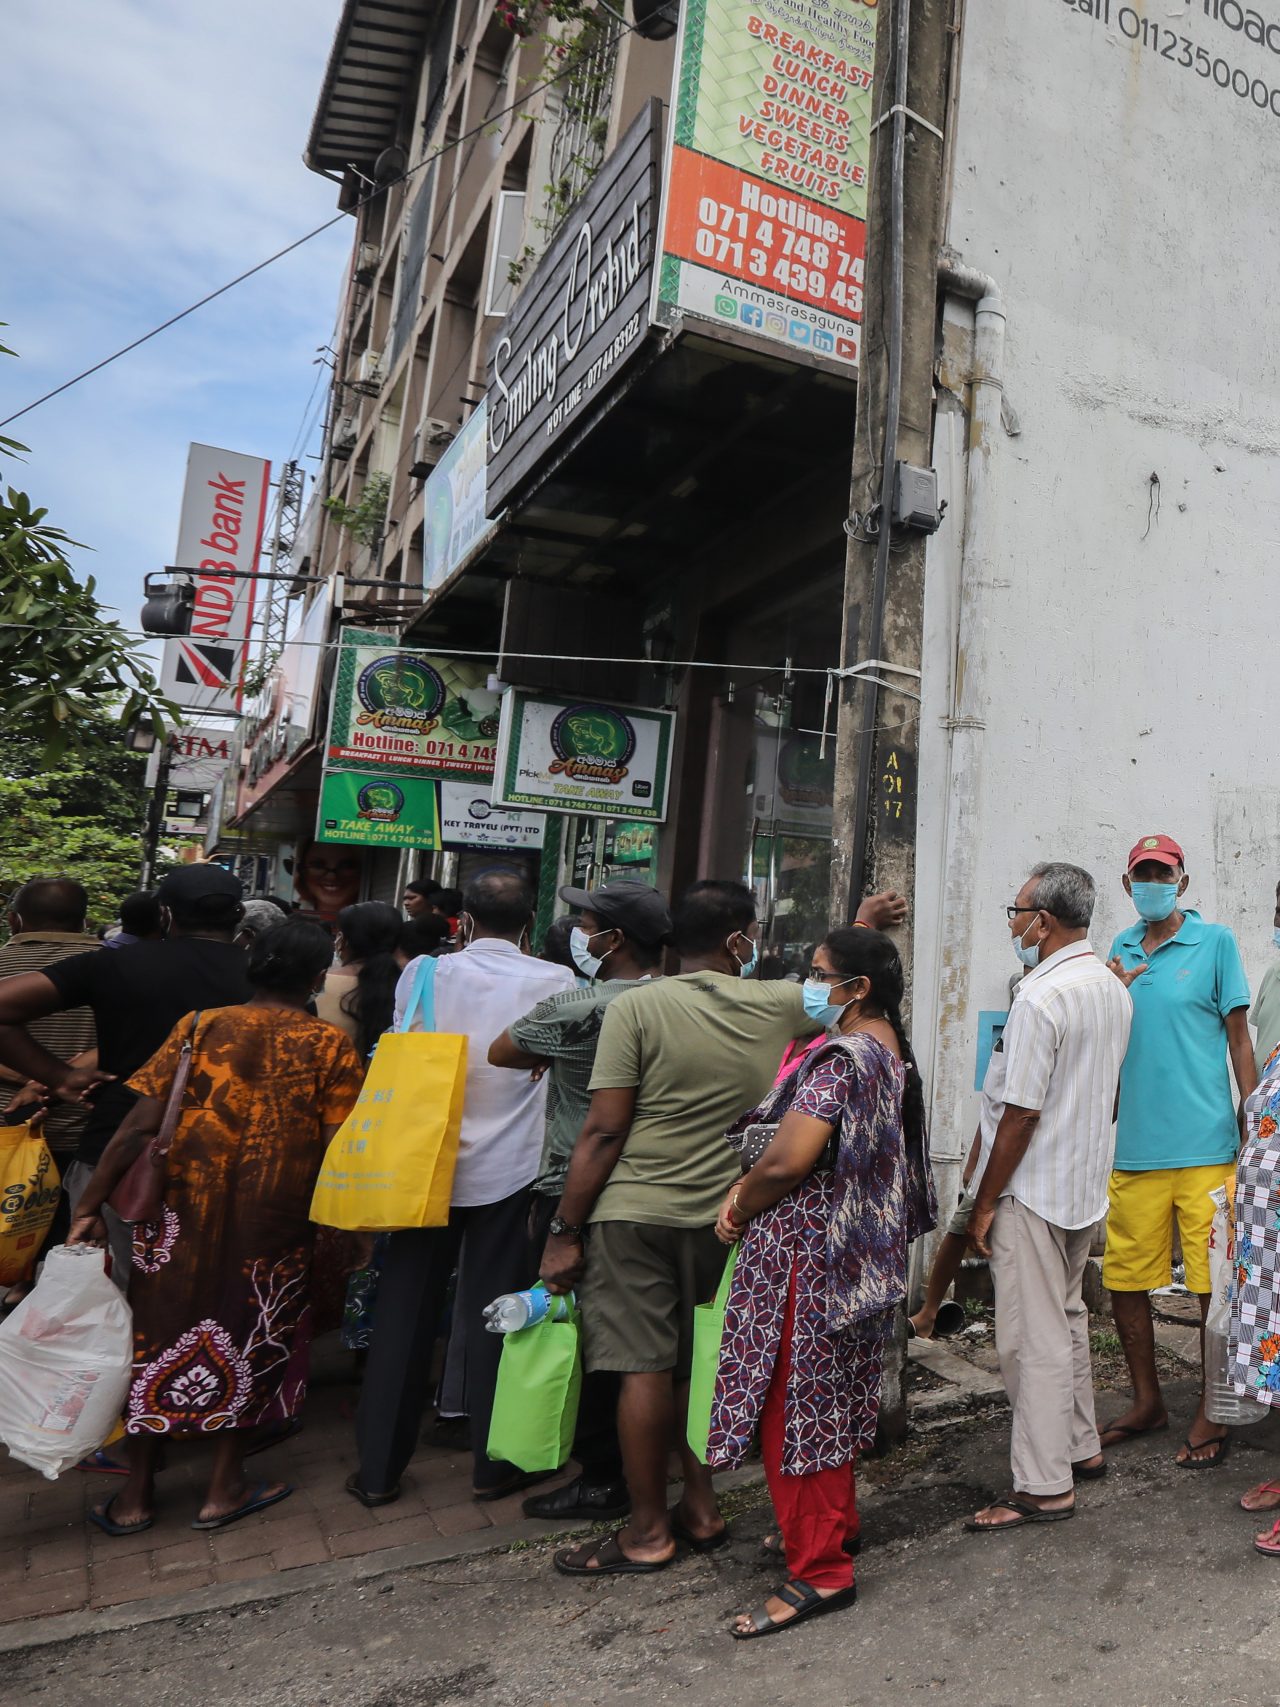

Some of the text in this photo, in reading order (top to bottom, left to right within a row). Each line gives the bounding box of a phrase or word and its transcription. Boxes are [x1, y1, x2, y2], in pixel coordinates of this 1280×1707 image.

[807, 7, 849, 37] Healthy
[747, 15, 873, 88] BREAKFAST
[772, 53, 847, 101] LUNCH
[763, 75, 851, 130] DINNER
[739, 115, 865, 184] VEGETABLE
[759, 101, 849, 152] SWEETS
[761, 152, 841, 198] FRUITS
[699, 197, 749, 239] 071
[755, 220, 774, 248] 4
[781, 228, 830, 270] 748
[740, 181, 846, 247] Hotline:
[695, 228, 744, 269] 071
[749, 248, 768, 277] 3
[772, 258, 826, 299] 439
[490, 200, 641, 454] Smiling Orchid
[721, 279, 854, 337] Ammasrasaguna
[547, 403, 564, 436] HOT
[564, 382, 582, 416] LINE
[587, 357, 603, 389] 077
[602, 345, 614, 371] 44
[614, 313, 640, 359] 83122
[191, 472, 246, 638] NDB bank
[339, 749, 381, 761] BREAKFAST
[388, 755, 413, 764] LUNCH
[413, 757, 441, 766] DINNER
[353, 732, 419, 753] Hotline:
[426, 740, 454, 757] 071
[458, 744, 468, 758] 4
[886, 751, 898, 770] A
[548, 757, 629, 784] Ammas
[553, 783, 586, 797] TAKE
[585, 787, 624, 800] AWAY
[508, 794, 545, 804] HOTLINE
[549, 799, 563, 807] 071
[884, 799, 902, 819] 17
[324, 830, 366, 840] HOTLINE
[372, 833, 388, 842] 071
[391, 835, 397, 843] 4
[399, 836, 415, 844] 748
[416, 837, 433, 845] 748
[340, 819, 373, 831] TAKE
[374, 822, 414, 834] AWAY
[444, 820, 461, 828] KEY
[463, 821, 498, 831] TRAVELS
[500, 825, 522, 834] (PVT)
